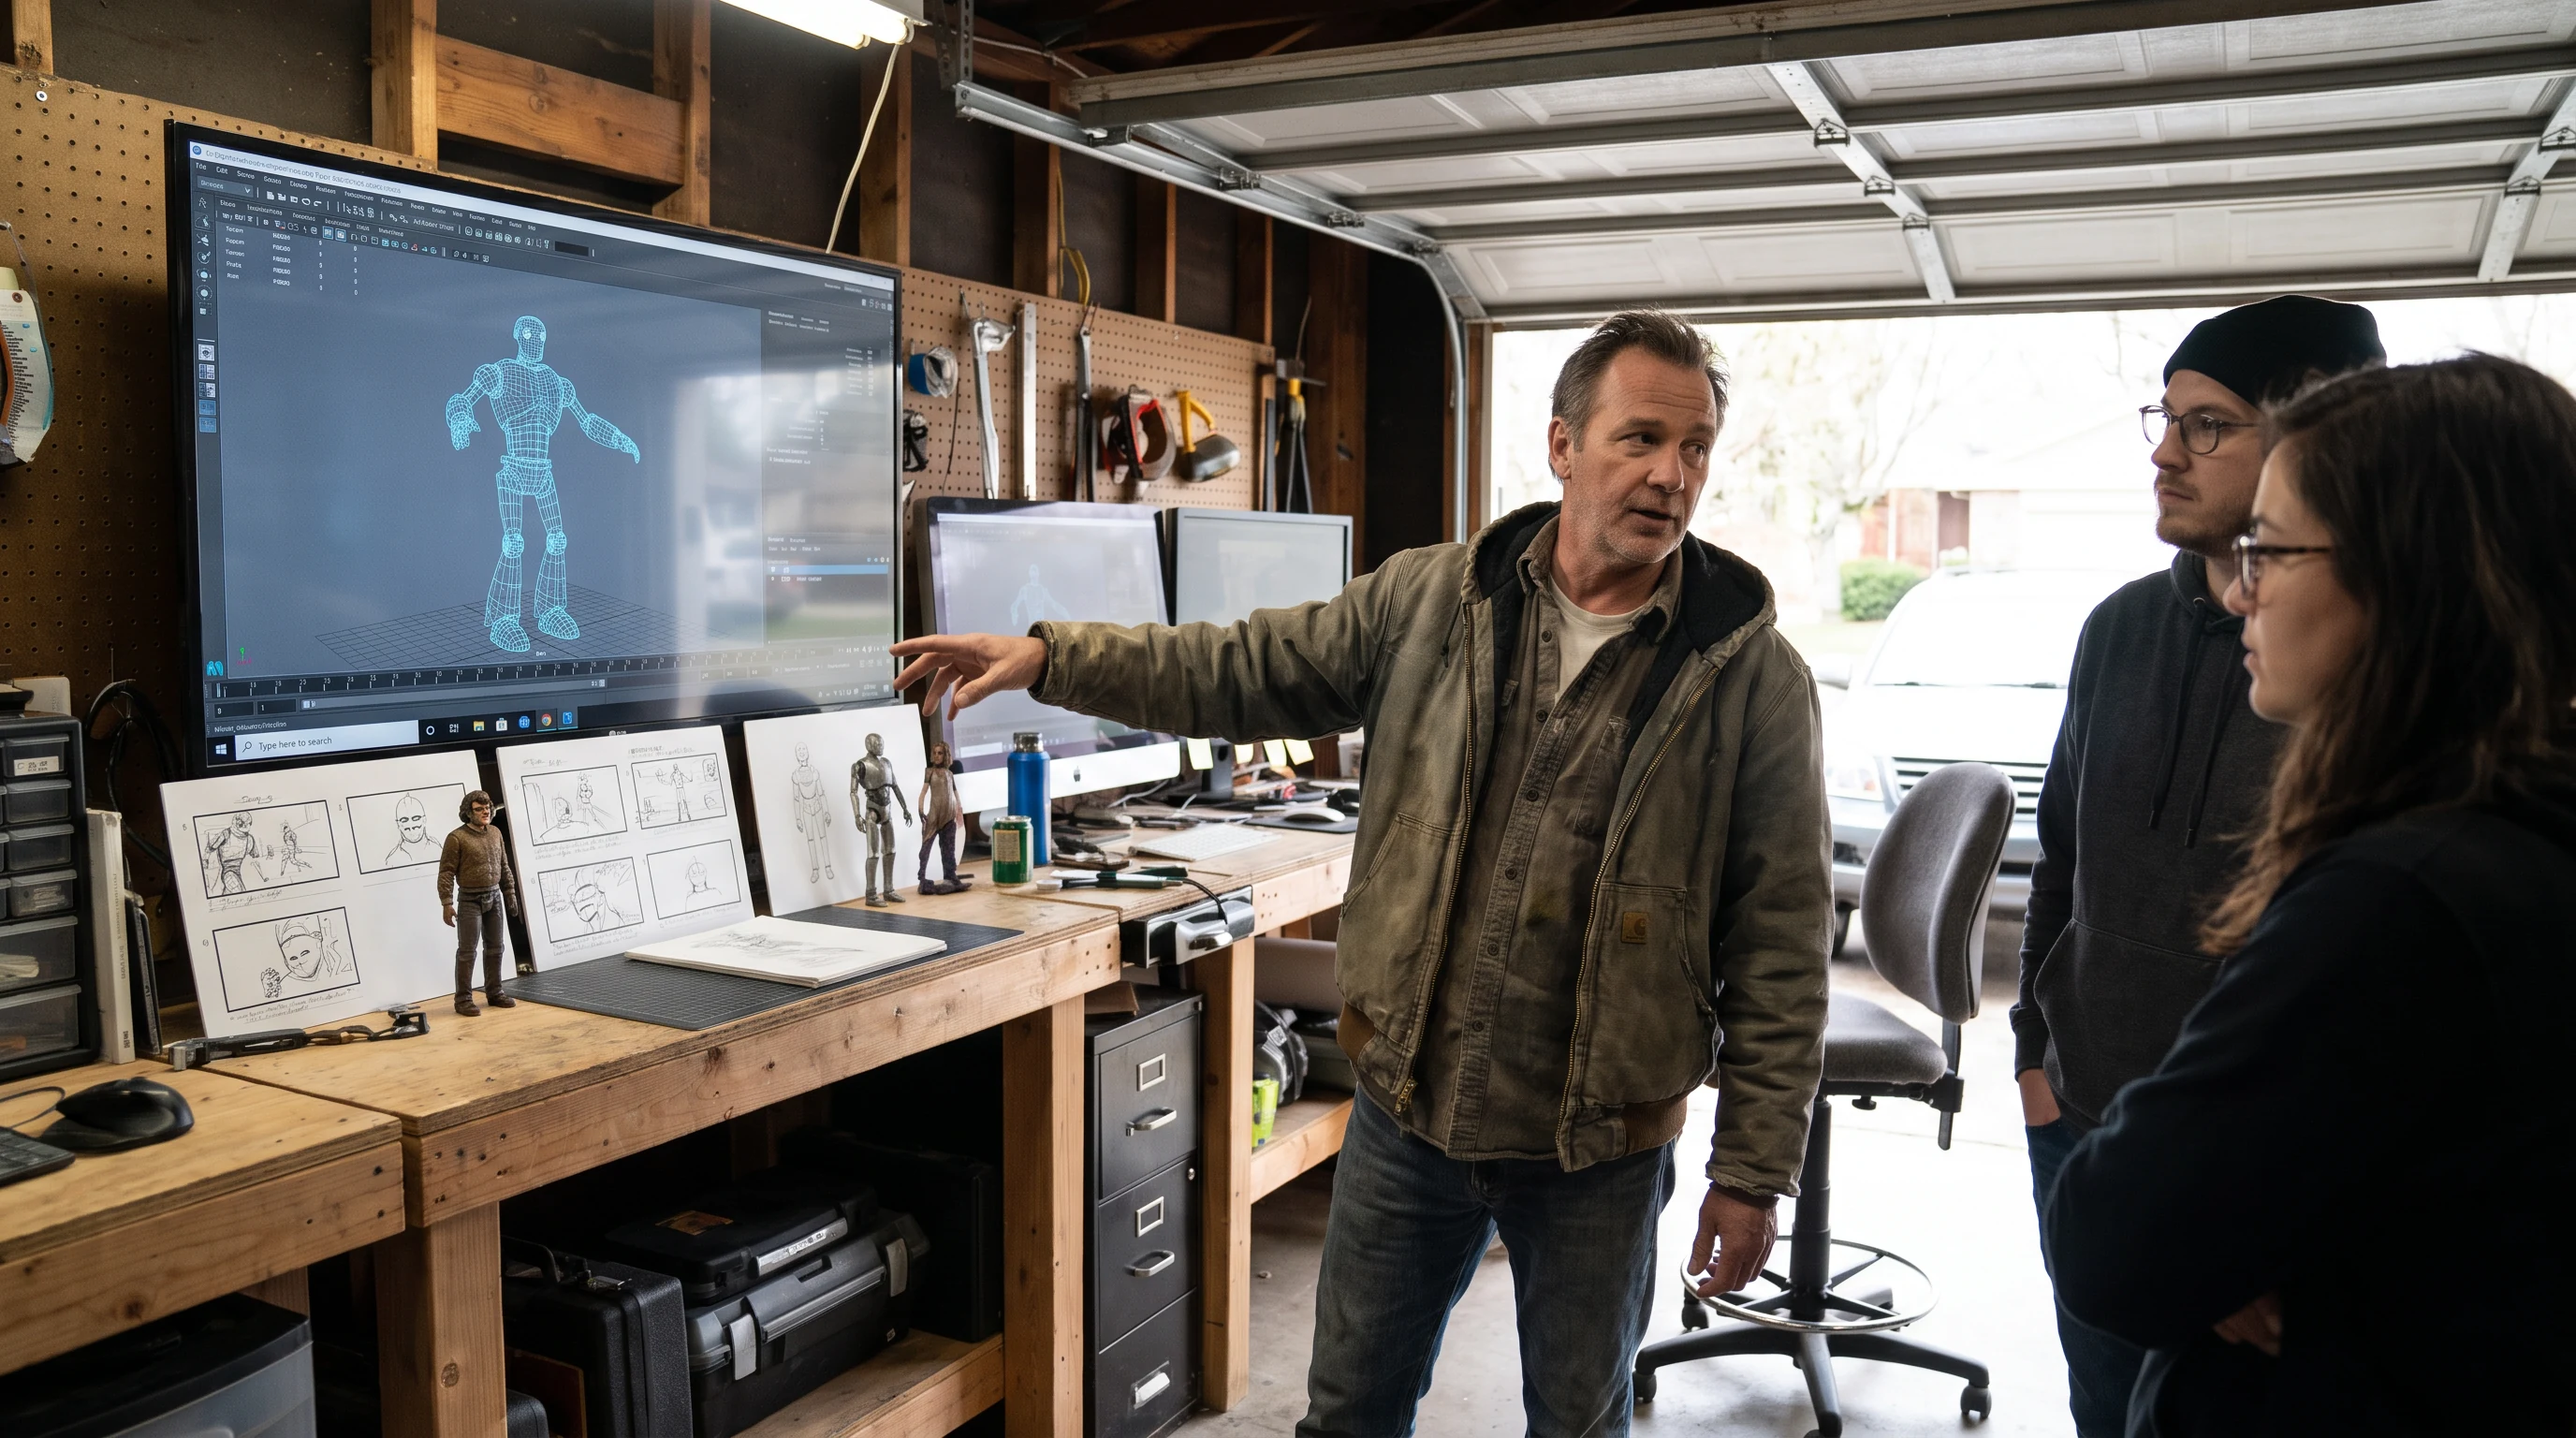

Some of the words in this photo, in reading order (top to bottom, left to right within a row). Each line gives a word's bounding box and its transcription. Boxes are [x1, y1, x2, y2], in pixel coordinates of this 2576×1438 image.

[258, 741, 277, 753] Type
[278, 741, 297, 749] here
[298, 738, 306, 747] to
[308, 736, 332, 746] search
